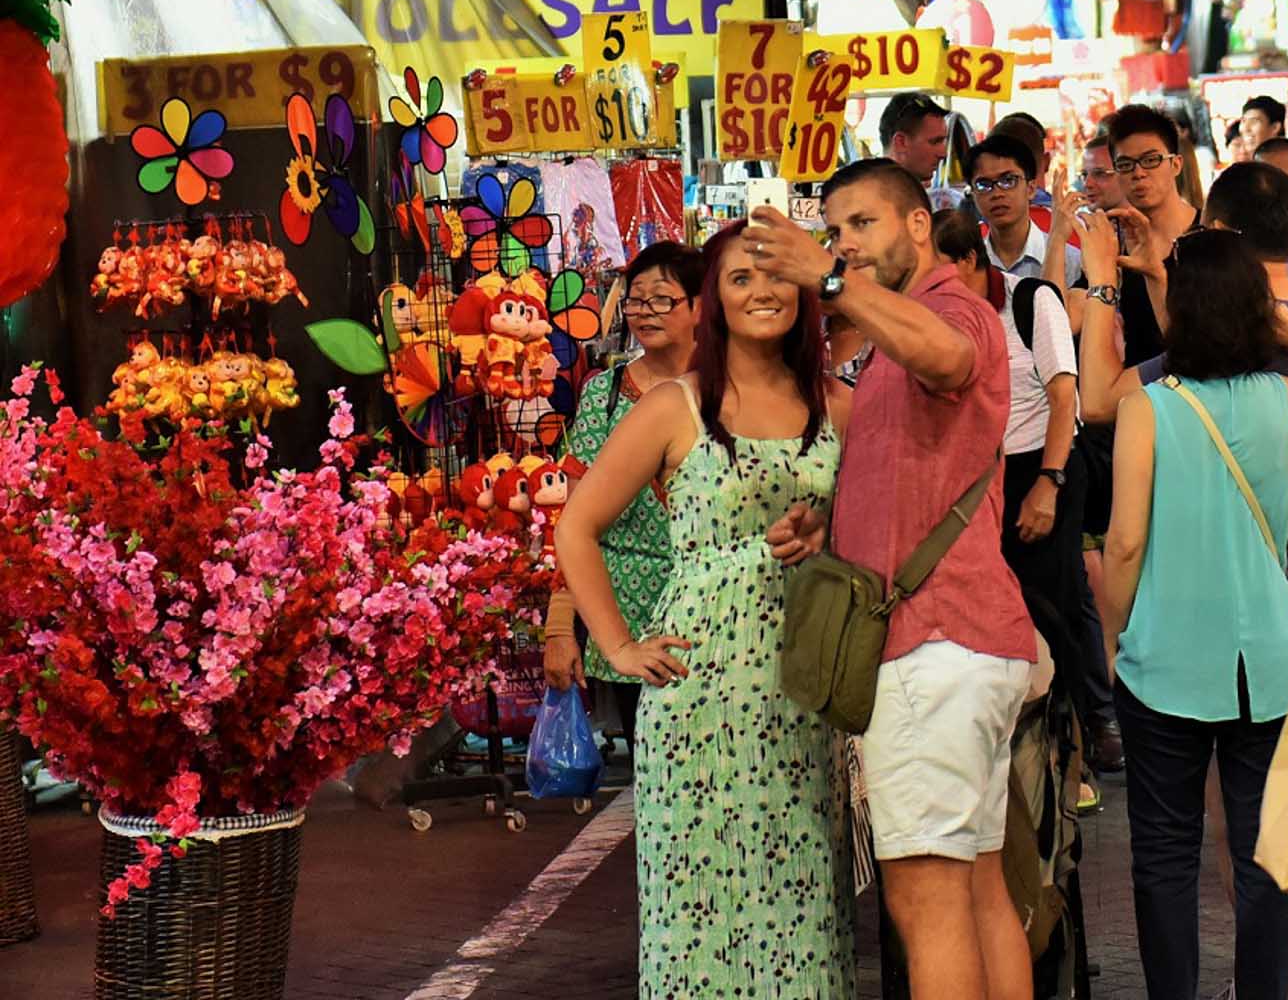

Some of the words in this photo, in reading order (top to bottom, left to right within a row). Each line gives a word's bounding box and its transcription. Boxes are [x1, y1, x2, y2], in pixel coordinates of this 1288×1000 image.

[602, 14, 626, 62] 5
[749, 23, 775, 70] 7
[847, 33, 920, 80] $10
[121, 64, 155, 121] 3
[165, 63, 257, 101] FOR
[278, 50, 355, 107] $9
[724, 72, 793, 105] FOR
[944, 46, 1004, 95] $2
[481, 89, 513, 143] 5
[525, 96, 581, 134] FOR
[594, 85, 649, 143] $10
